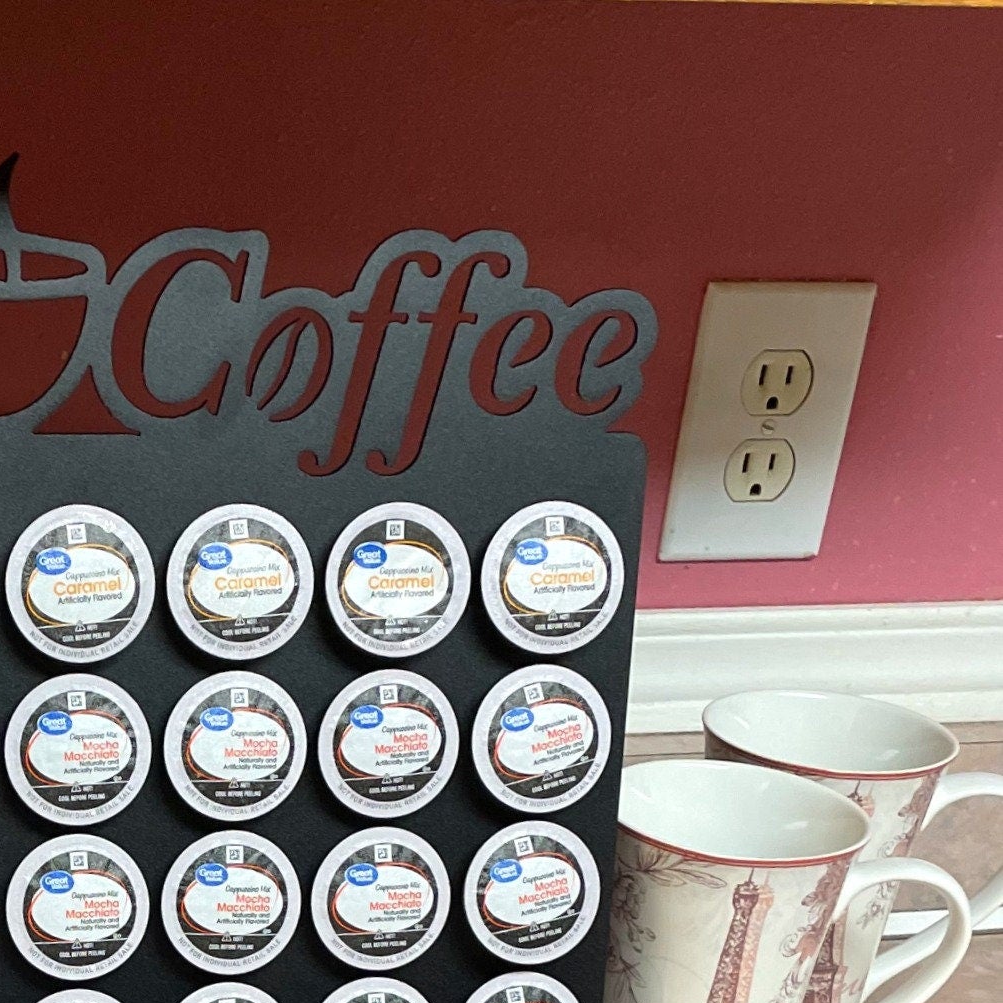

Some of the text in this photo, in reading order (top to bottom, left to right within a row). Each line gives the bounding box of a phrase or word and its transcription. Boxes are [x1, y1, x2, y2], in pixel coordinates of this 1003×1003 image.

[110, 248, 638, 477] Coffee
[214, 571, 281, 590] Caramel
[368, 574, 433, 589] Caramel
[530, 568, 594, 585] Caramel
[53, 576, 121, 596] Caramel
[394, 732, 428, 742] Mocha
[83, 740, 118, 750] Mocha
[243, 739, 277, 747] Mocha
[375, 741, 428, 753] Macchiato
[64, 750, 118, 760] Macchiato
[224, 748, 277, 756] Macchiato
[236, 894, 270, 903] Mocha
[387, 891, 421, 900] Mocha
[84, 899, 119, 908] Mocha
[217, 903, 270, 911] Macchiato
[369, 899, 421, 910] Macchiato
[66, 908, 119, 918] Macchiato
